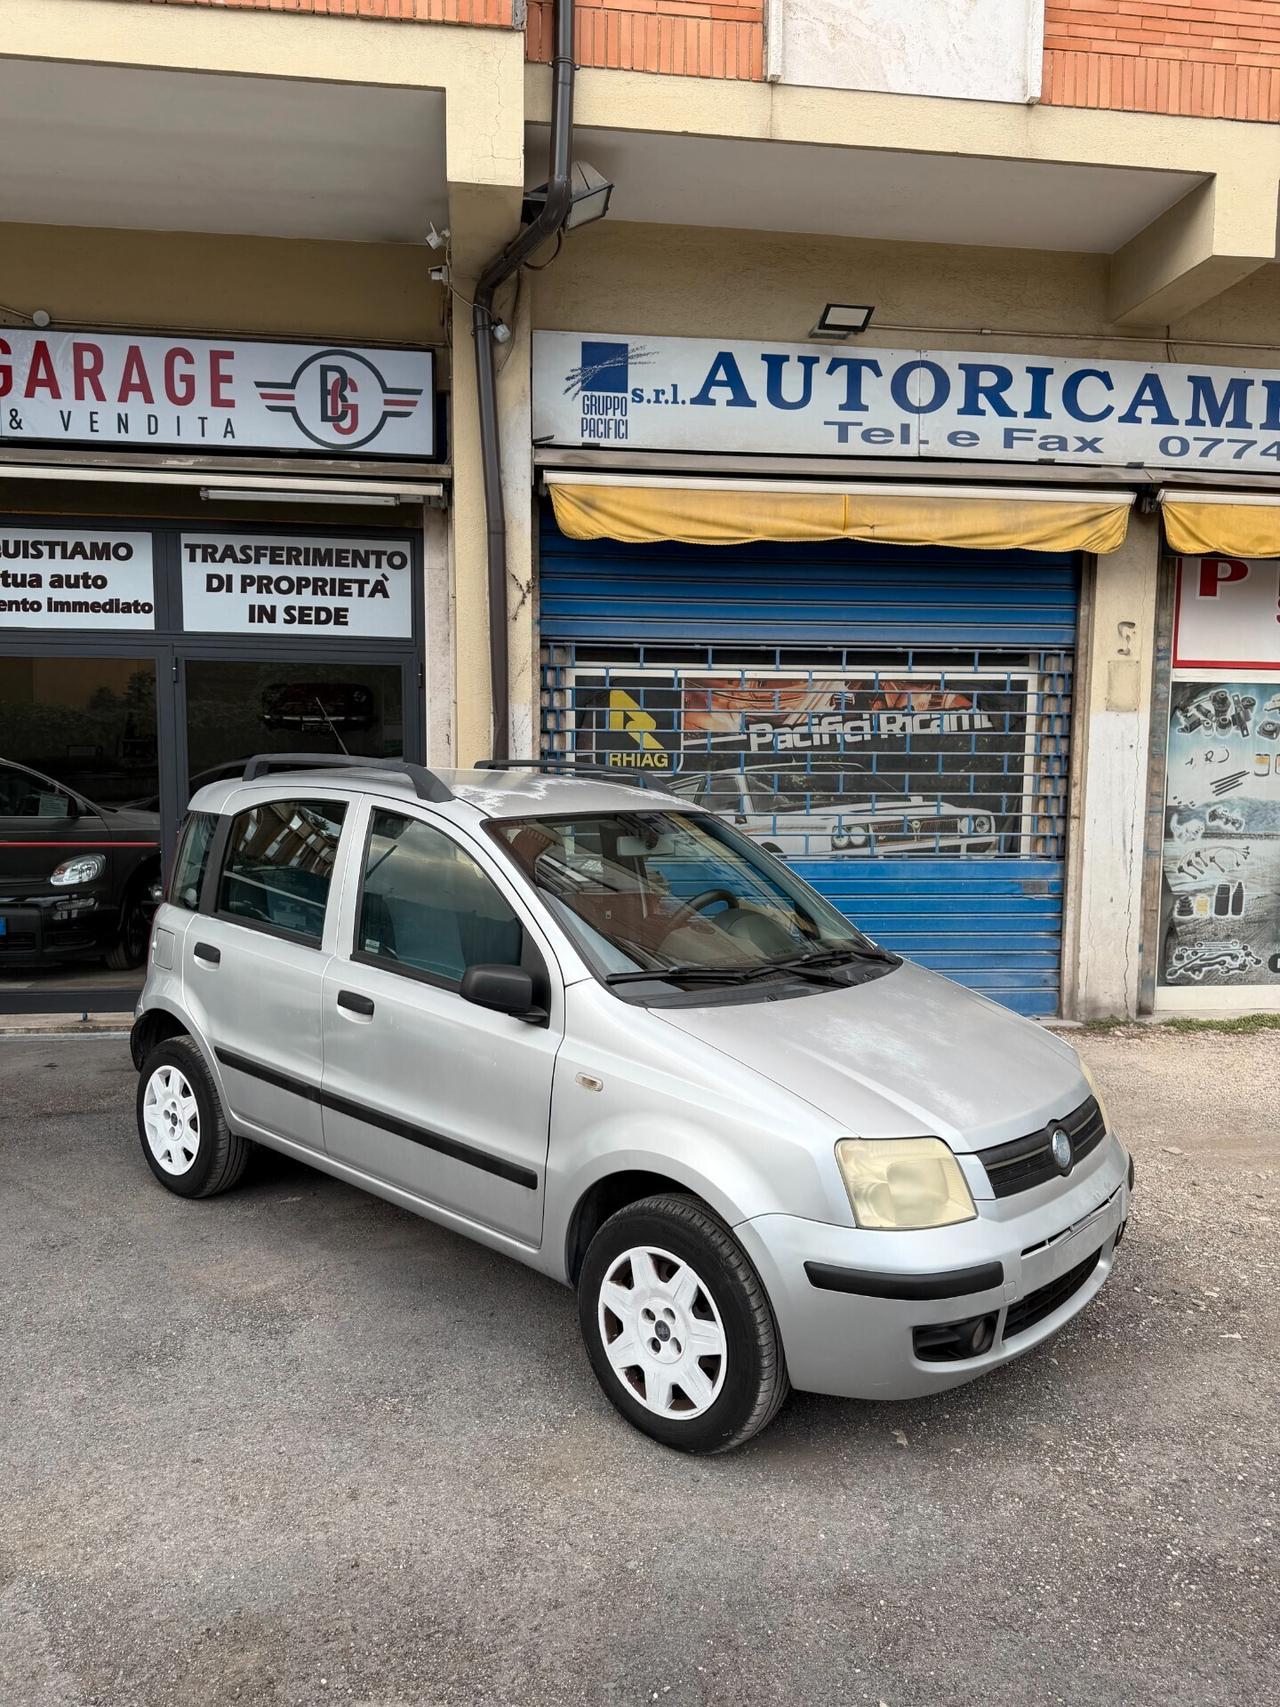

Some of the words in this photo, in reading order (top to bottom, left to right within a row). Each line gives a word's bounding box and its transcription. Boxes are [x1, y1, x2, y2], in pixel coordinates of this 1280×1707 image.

[631, 383, 686, 405] s.r.l.
[582, 394, 628, 417] GRUPPO
[60, 410, 236, 439] VENDITA
[581, 417, 628, 440] PACIFICI
[947, 430, 981, 448] e
[1003, 428, 1104, 454] Fax
[0, 540, 133, 561] UISTIAMO
[184, 543, 408, 570] TRASFERIMENTO
[0, 570, 42, 588] tua
[49, 571, 108, 589] auto
[206, 573, 232, 593] DI
[240, 573, 390, 599] PROPRIETÀ
[47, 597, 153, 614] immediato
[248, 604, 276, 624] IN
[283, 605, 349, 626] SEDE
[609, 752, 668, 768] RHIAG
